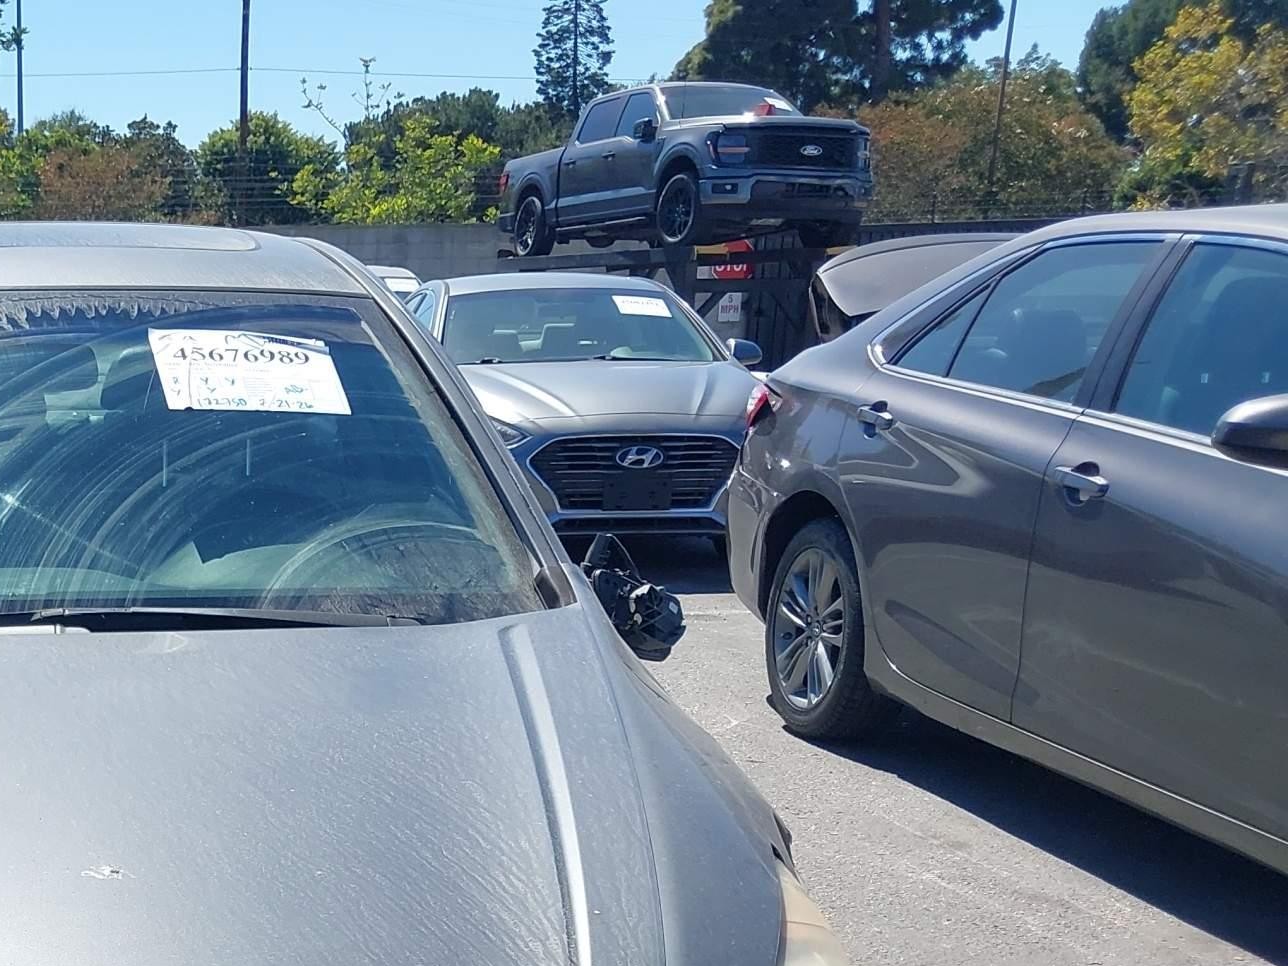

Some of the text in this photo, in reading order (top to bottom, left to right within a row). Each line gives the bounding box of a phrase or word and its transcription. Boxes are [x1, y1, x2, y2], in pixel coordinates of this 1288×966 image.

[727, 294, 733, 303] 5
[720, 304, 739, 313] MPH
[173, 347, 310, 365] 45676989
